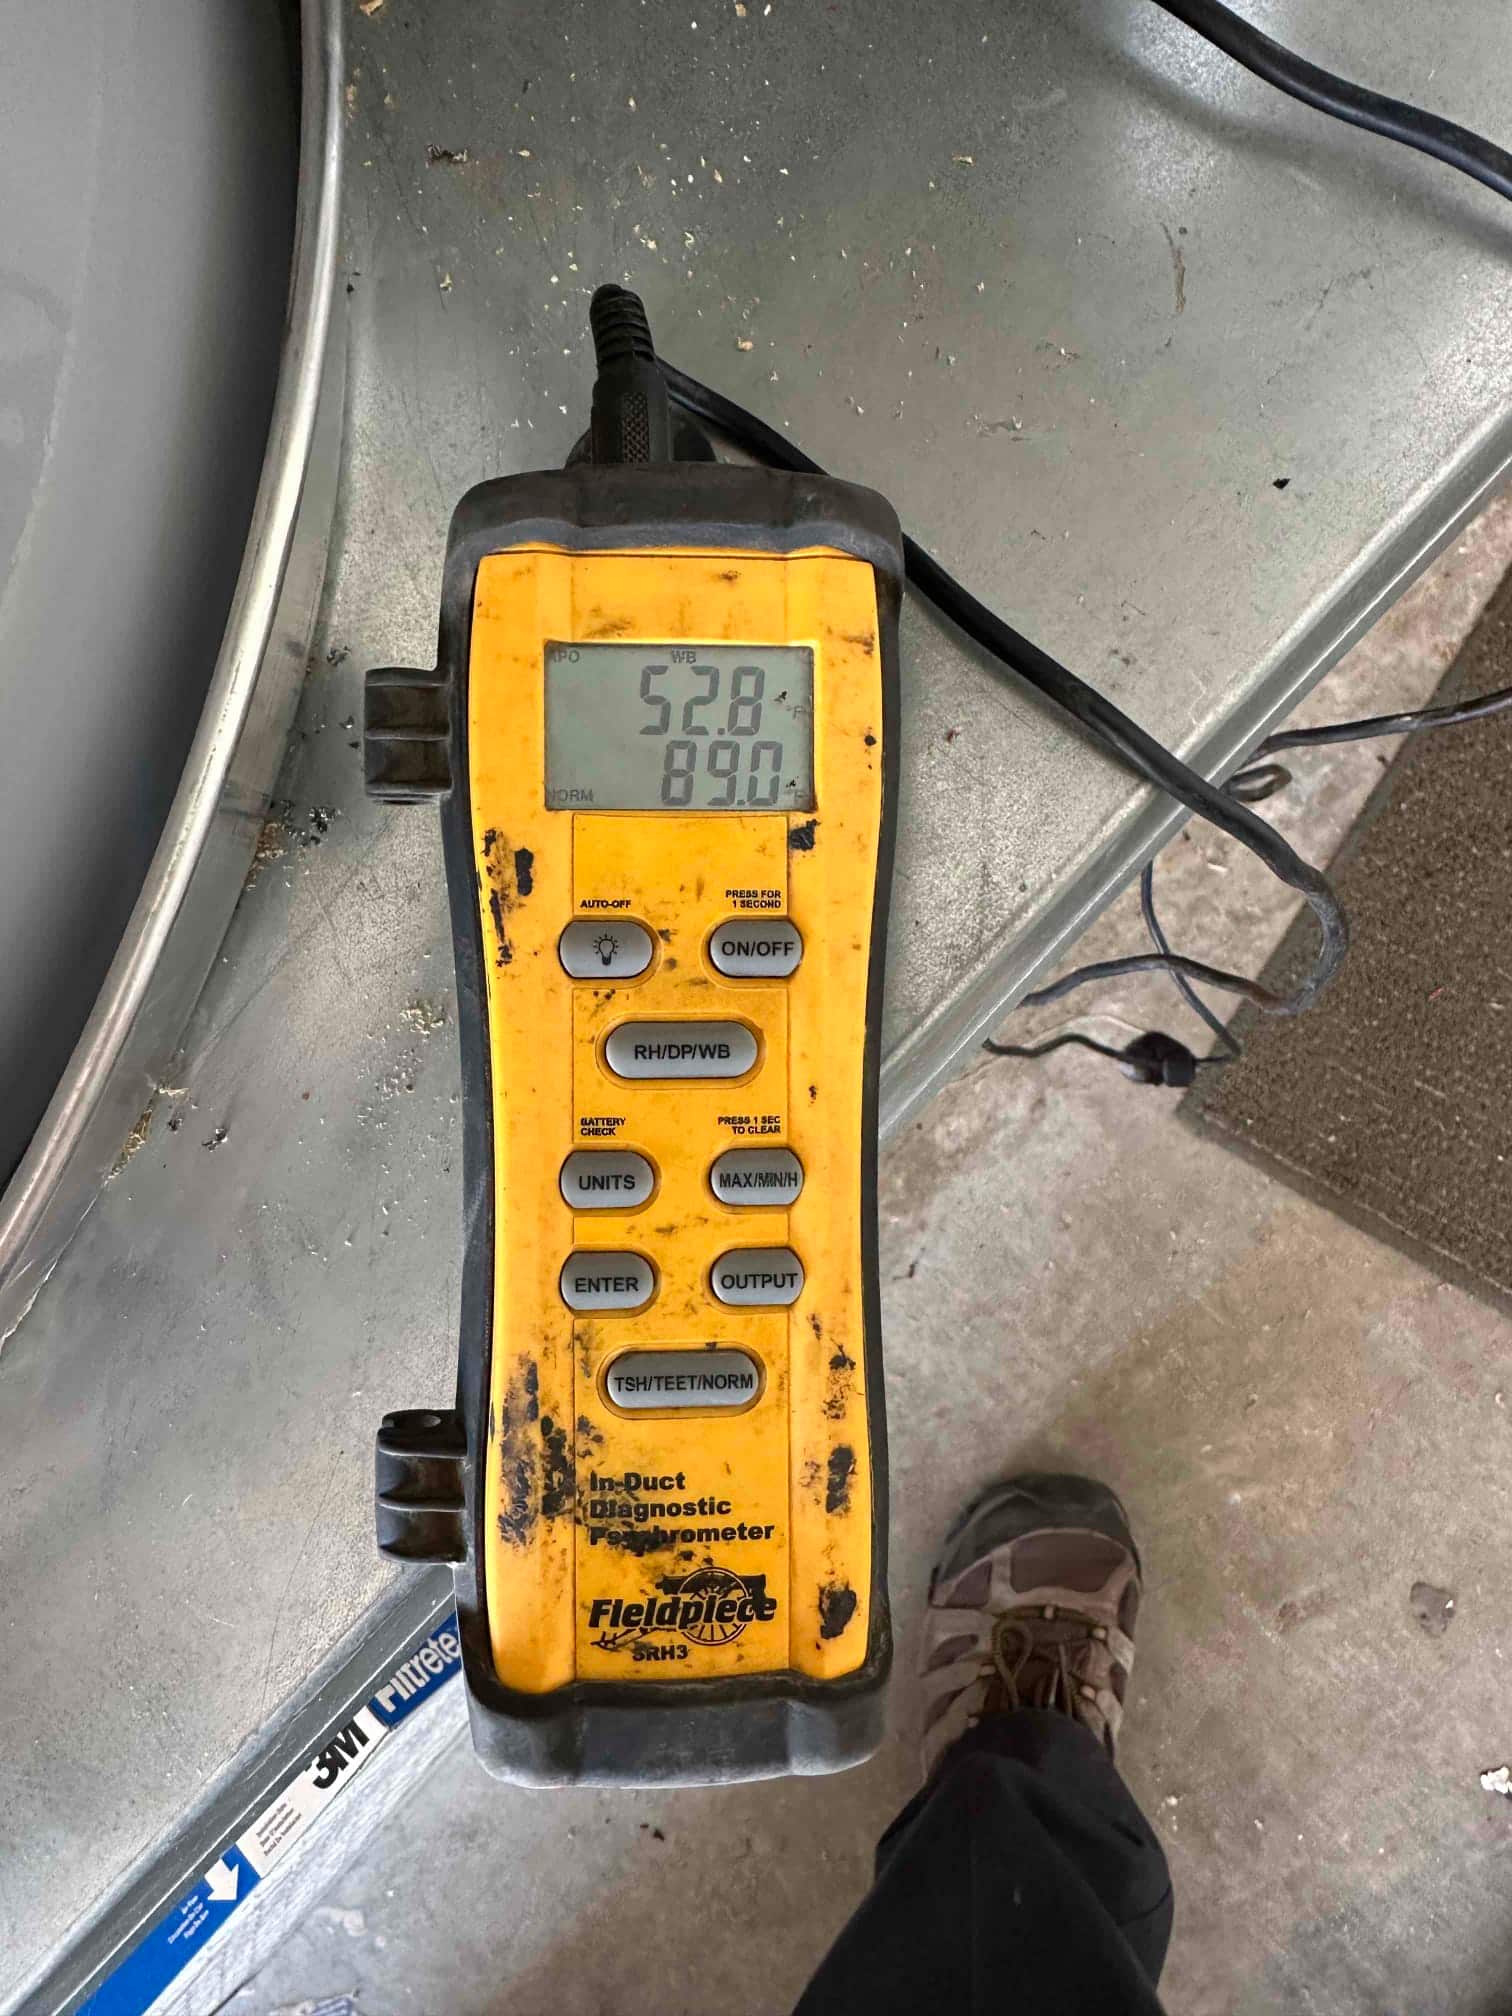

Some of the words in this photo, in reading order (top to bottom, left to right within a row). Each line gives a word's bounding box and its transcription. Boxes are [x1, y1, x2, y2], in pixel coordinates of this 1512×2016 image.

[671, 650, 697, 664] WB
[640, 665, 765, 736] 52.8
[661, 740, 783, 807] 89.0
[725, 890, 759, 899] PRESS
[761, 890, 782, 899] FOR
[580, 899, 632, 909] AUTO-OFF
[740, 900, 782, 909] SECOND
[721, 941, 795, 957] ON/OFF
[634, 1044, 731, 1060] RH/DP/WB
[580, 1117, 626, 1127] BATTERY
[717, 1116, 751, 1125] PRESS
[761, 1115, 781, 1125] SEC
[580, 1127, 616, 1137] CHECK
[732, 1125, 746, 1135] TO
[748, 1125, 781, 1134] CLEAR
[578, 1174, 636, 1191] UNITS
[719, 1171, 798, 1188] MAX/MIN/H
[574, 1276, 639, 1293] ENTER
[721, 1273, 798, 1290] OUTPUT
[614, 1374, 753, 1392] TSH/TEET/NORM
[589, 1470, 686, 1491] In-Duct
[589, 1497, 732, 1522] Diagnostic
[588, 1594, 778, 1630] Fieldpiece
[313, 1719, 369, 1789] 3M
